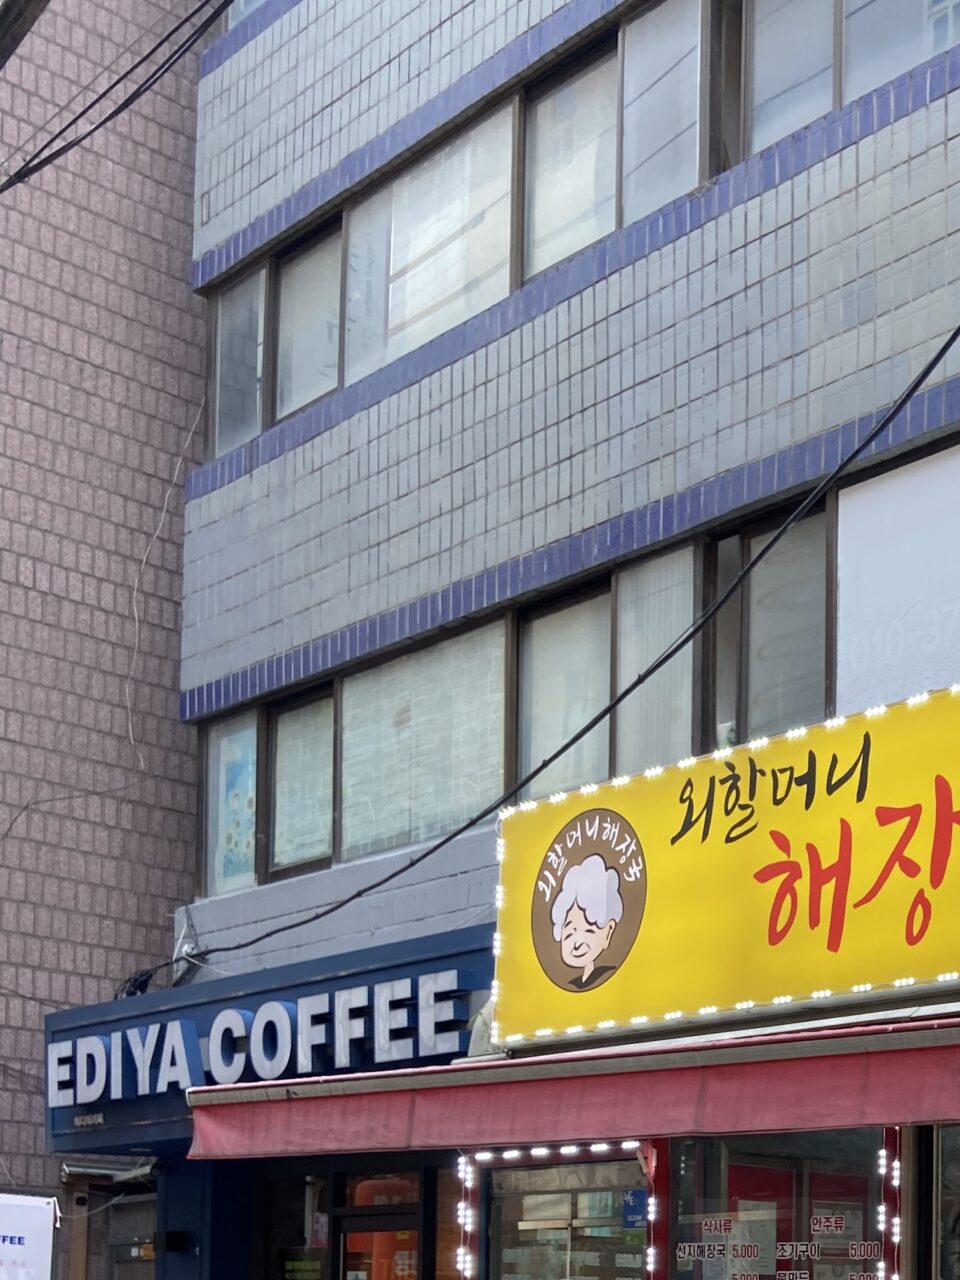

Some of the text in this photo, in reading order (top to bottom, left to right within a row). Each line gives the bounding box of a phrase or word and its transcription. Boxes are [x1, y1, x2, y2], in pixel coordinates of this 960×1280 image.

[671, 731, 871, 845] 외할머니
[47, 970, 460, 1108] EDIYA COFFEE
[702, 1218, 733, 1234] 식사류
[811, 1215, 845, 1234] 안주류
[0, 1235, 25, 1246] FEE
[776, 1242, 821, 1260] 조기구이
